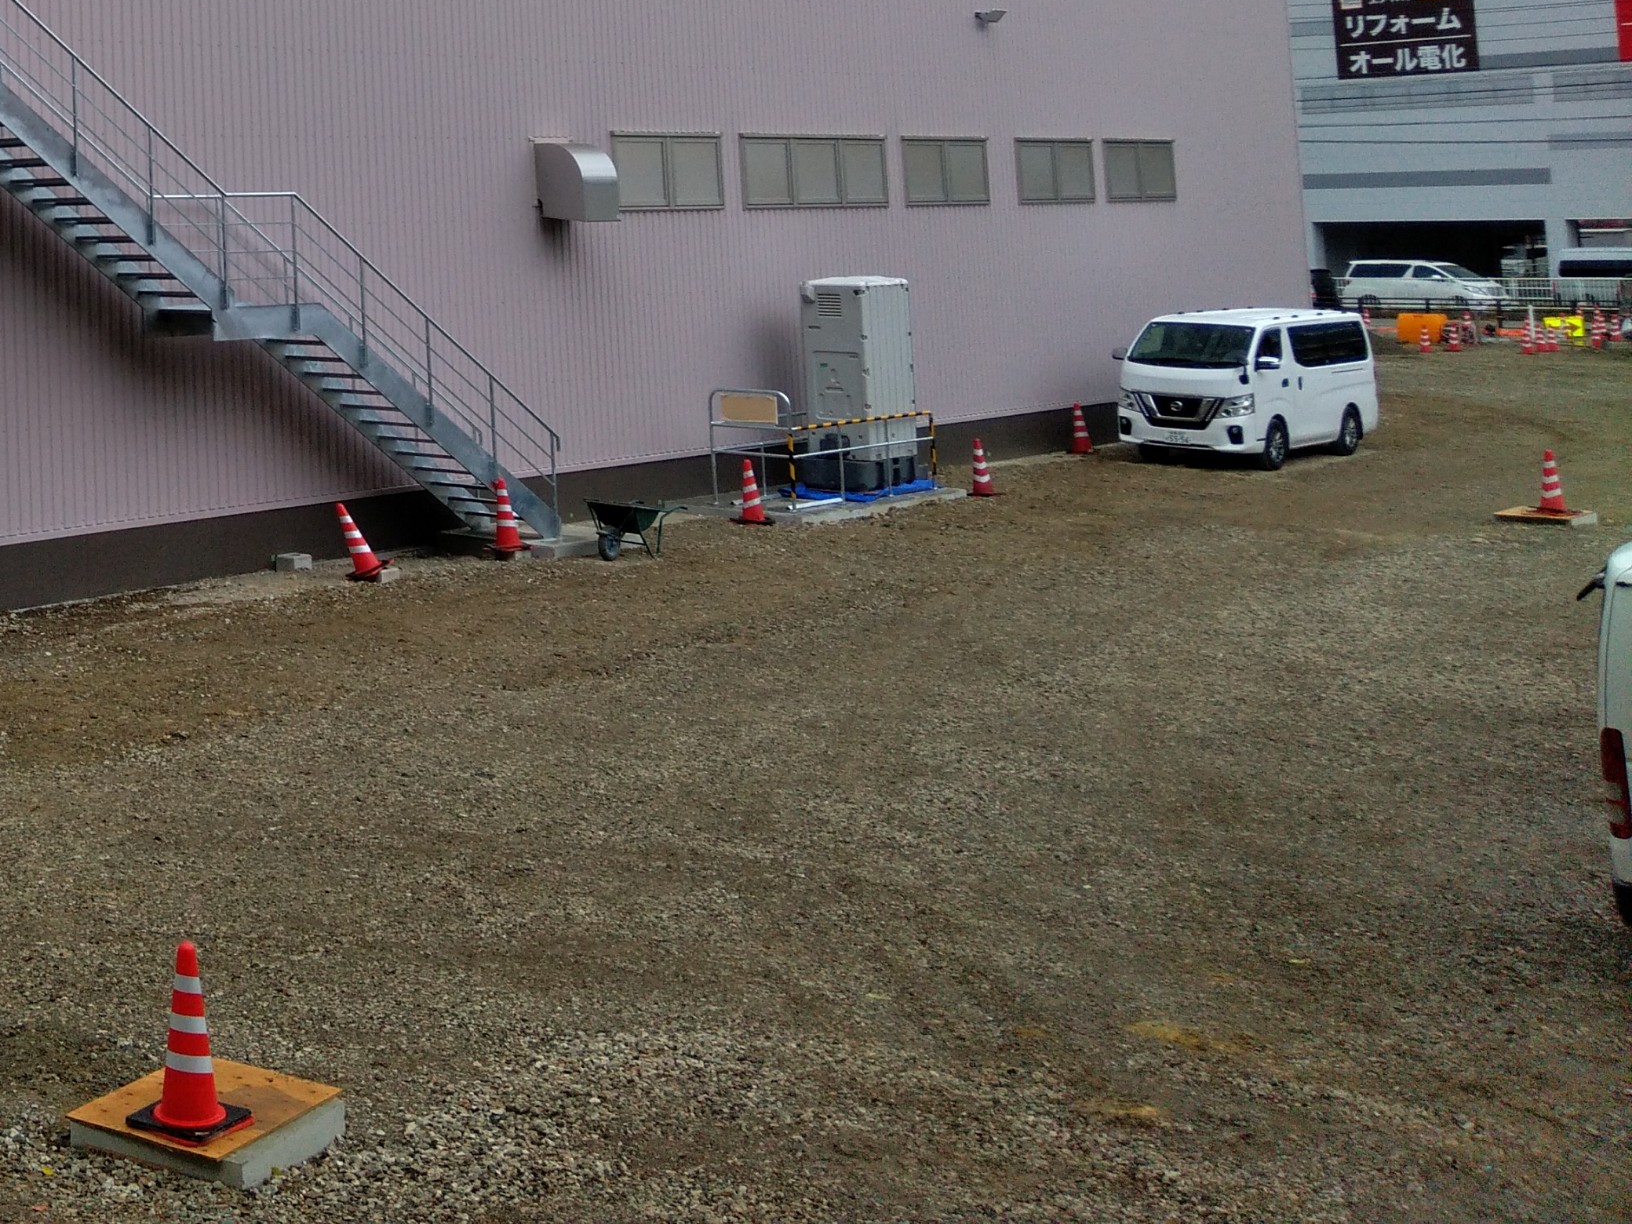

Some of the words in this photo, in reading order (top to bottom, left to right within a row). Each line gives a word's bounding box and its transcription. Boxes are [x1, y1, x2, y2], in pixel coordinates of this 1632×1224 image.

[1345, 7, 1462, 38] リフォーム
[1349, 43, 1467, 74] オール電化
